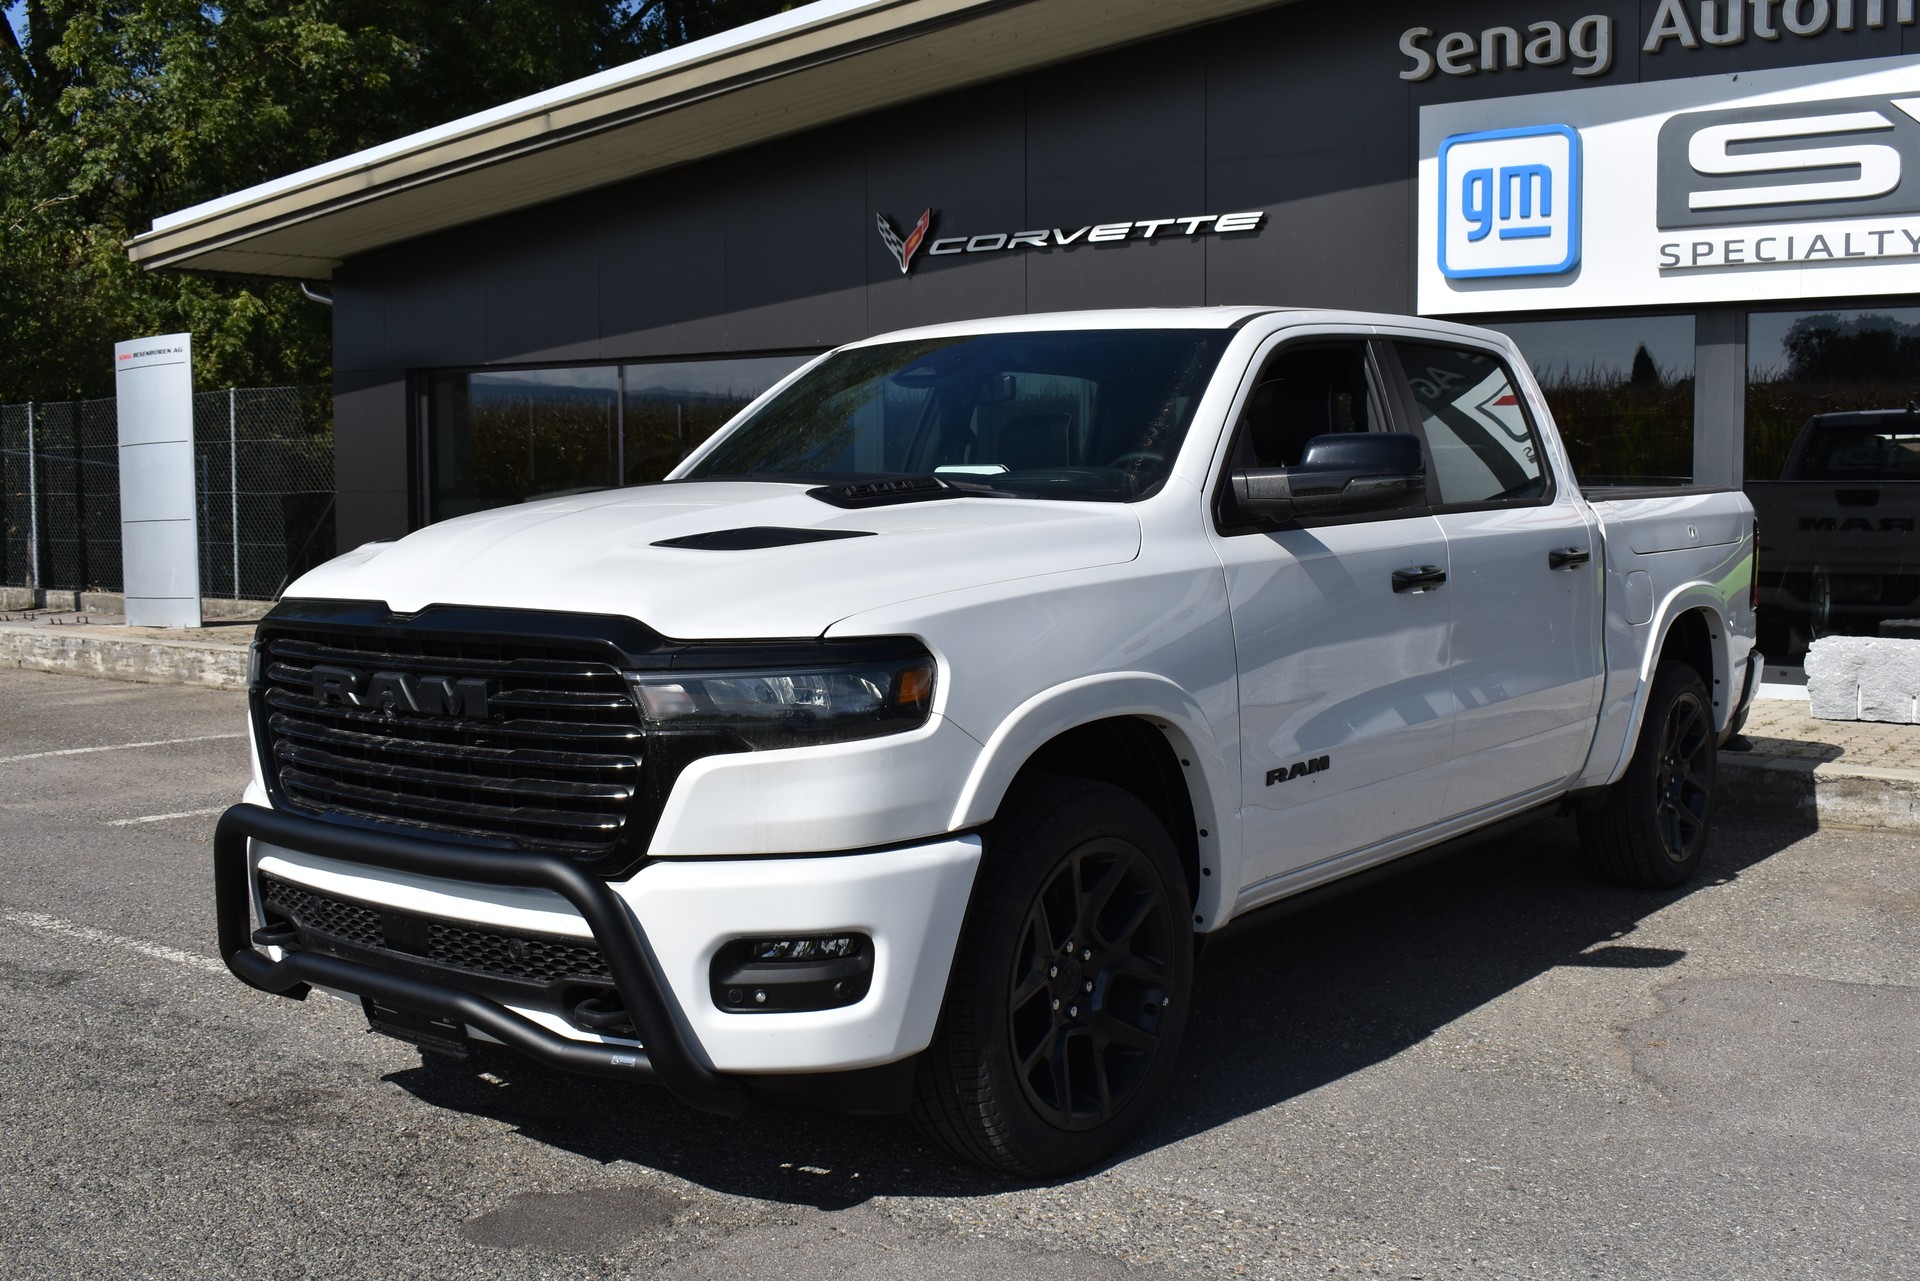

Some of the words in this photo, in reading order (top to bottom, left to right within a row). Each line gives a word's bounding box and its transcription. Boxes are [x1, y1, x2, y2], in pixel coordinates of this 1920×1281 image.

[1400, 14, 1613, 81] Senag
[1462, 164, 1552, 242] gm
[929, 211, 1264, 255] CORVETTE
[312, 665, 490, 718] RAM
[1266, 755, 1330, 787] RAM
